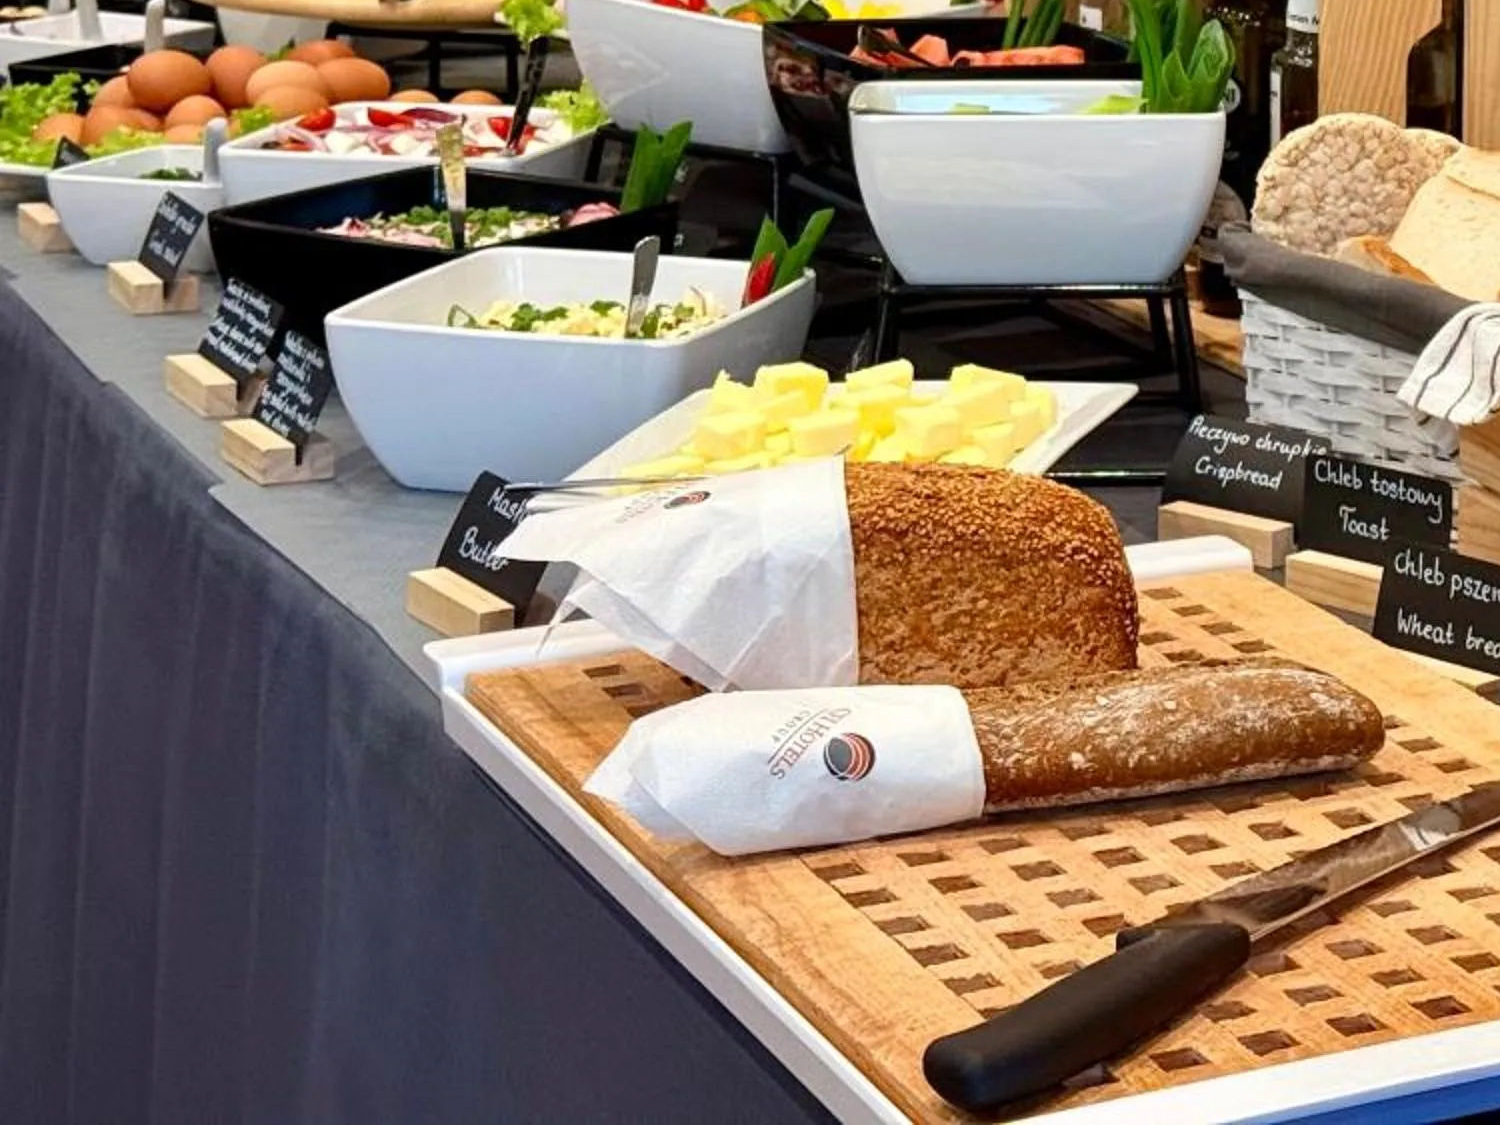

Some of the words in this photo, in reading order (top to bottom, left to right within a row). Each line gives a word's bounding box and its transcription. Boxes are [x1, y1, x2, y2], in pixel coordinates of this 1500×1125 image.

[1195, 455, 1283, 492] Crispbread
[1314, 458, 1364, 490] Chleb
[1370, 475, 1443, 524] tostowy
[1339, 505, 1392, 541] Toast
[1394, 547, 1445, 586] Chleb
[1397, 608, 1454, 644] Wheat
[769, 721, 831, 780] HOTELS
